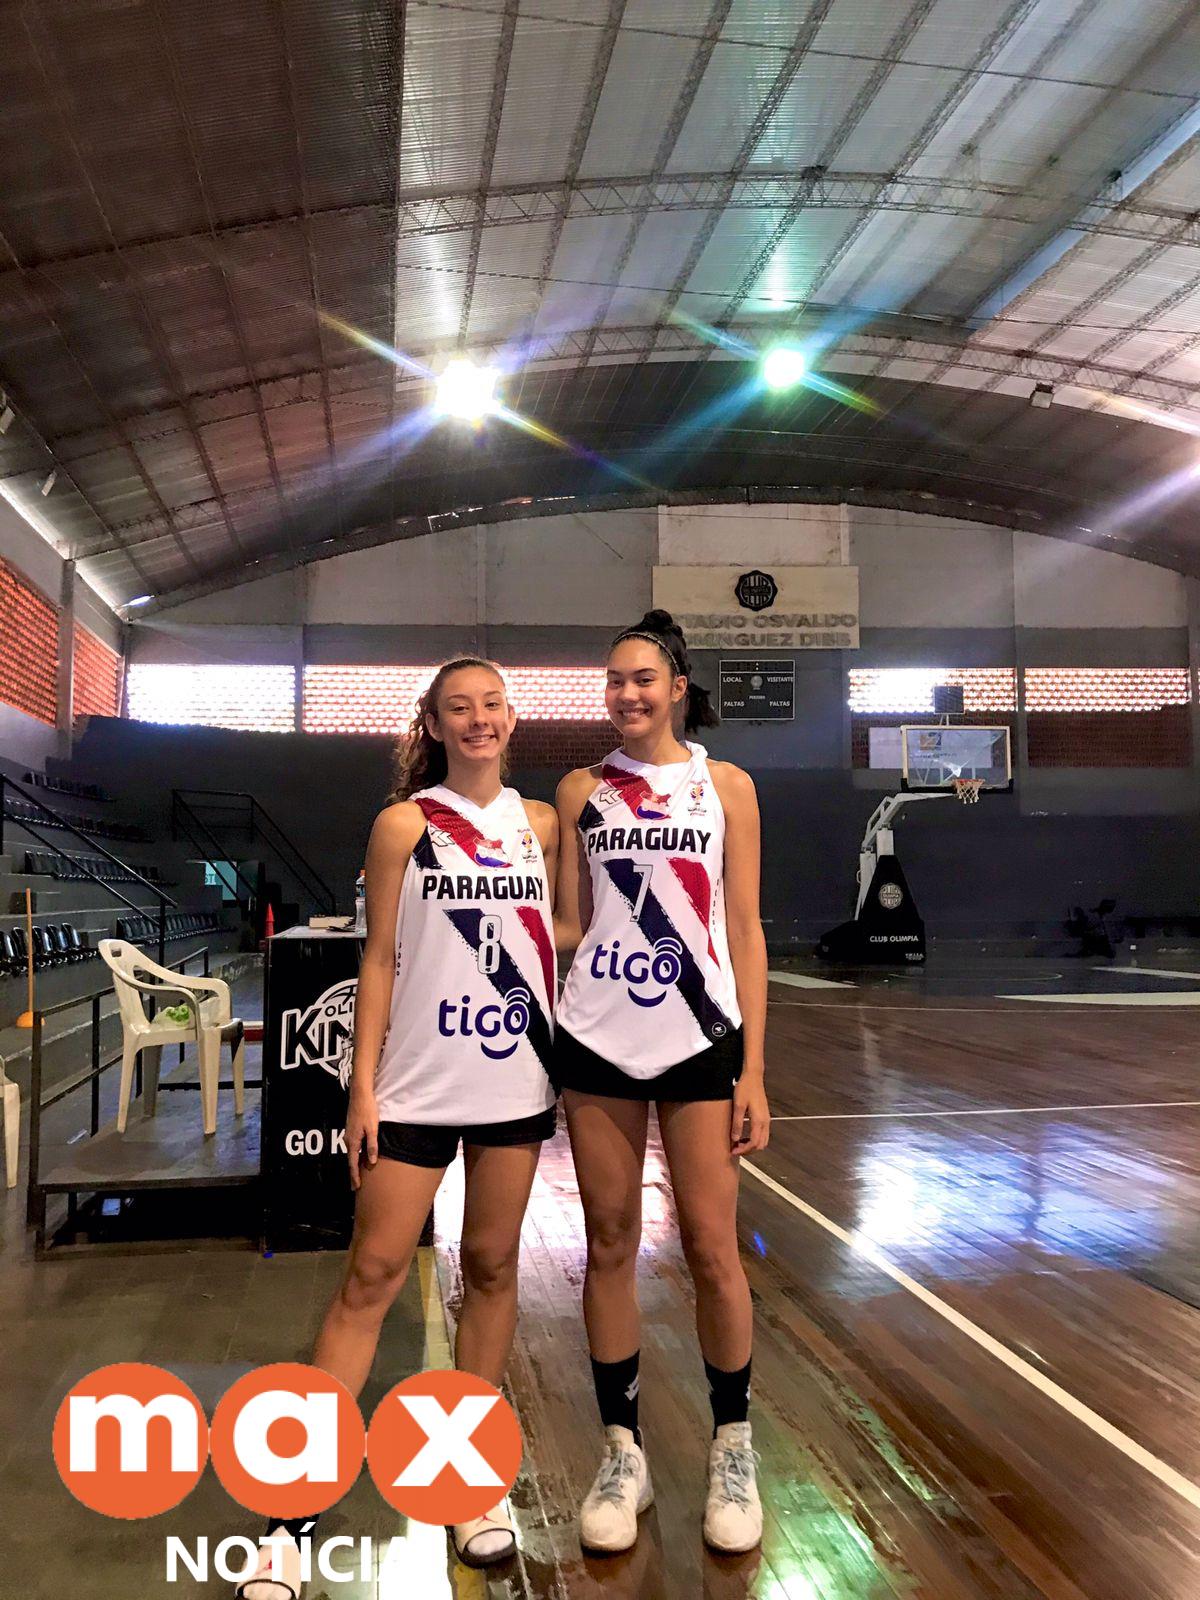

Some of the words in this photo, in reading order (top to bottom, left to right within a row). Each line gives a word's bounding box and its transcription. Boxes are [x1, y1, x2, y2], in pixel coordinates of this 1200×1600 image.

[673, 613, 746, 629] TADIO
[753, 613, 857, 628] OSVALDO
[587, 827, 712, 856] PARAGUAY
[422, 875, 543, 901] PARAGUAY
[629, 864, 653, 922] 7
[477, 914, 502, 974] 8
[869, 935, 888, 943] CLUB
[890, 935, 919, 943] OLIMPIA
[325, 1002, 353, 1017] OLI
[281, 1008, 350, 1070] KIN
[285, 1129, 324, 1155] GO
[331, 1128, 348, 1154] K
